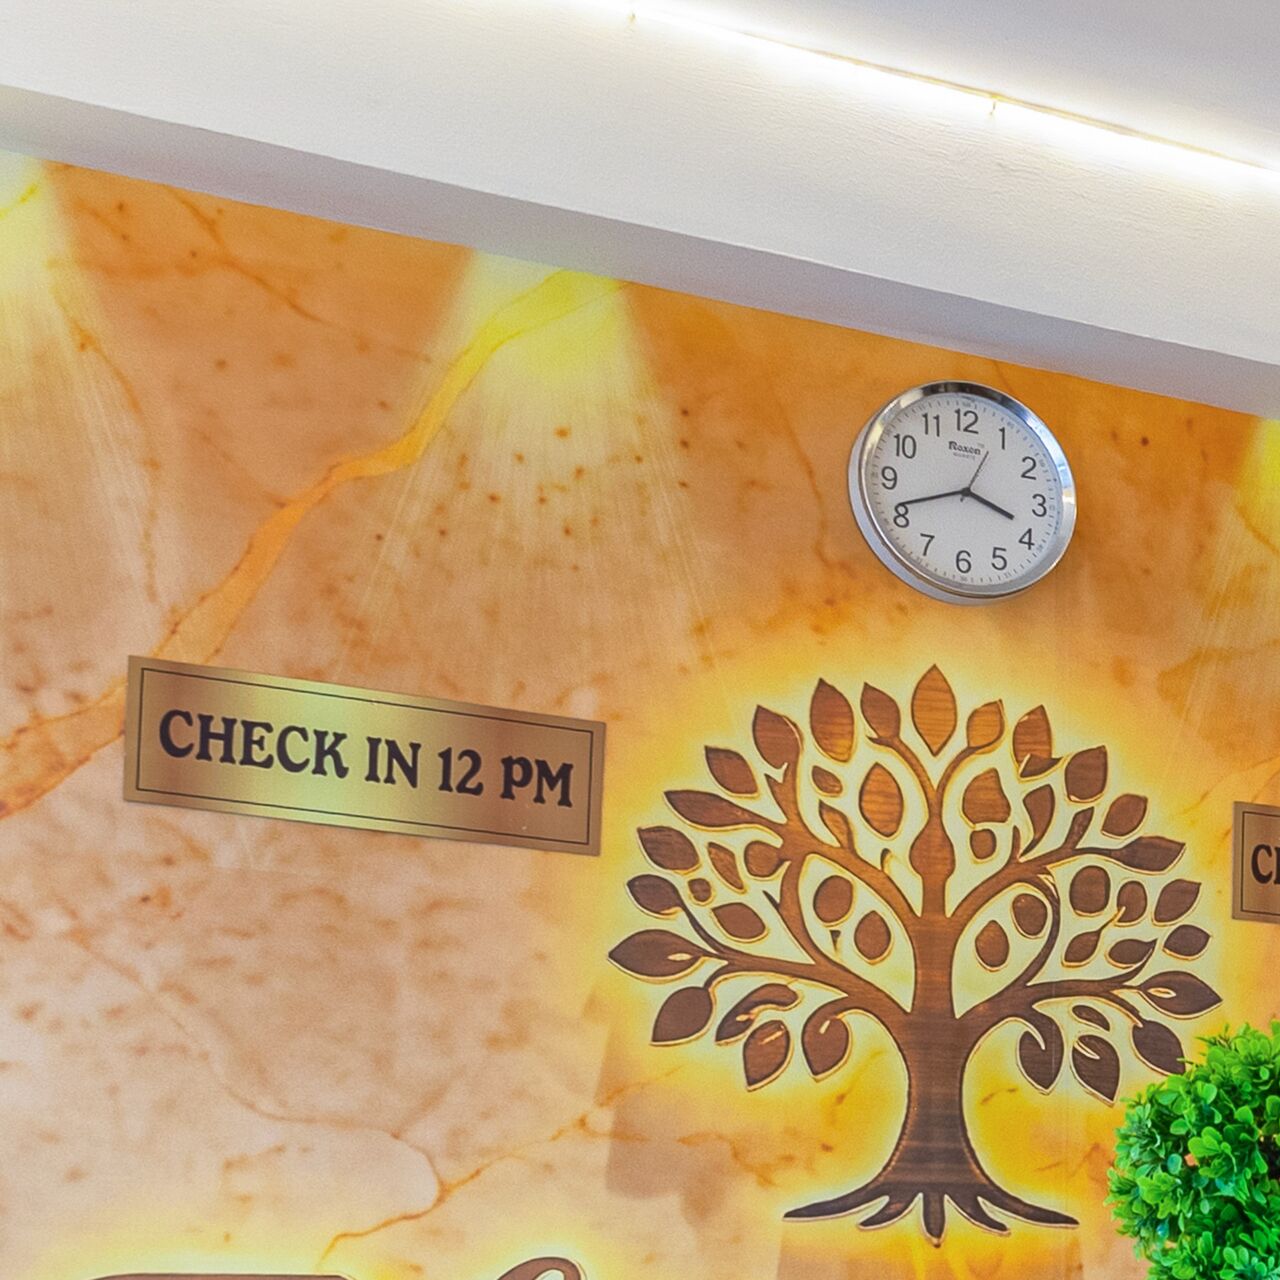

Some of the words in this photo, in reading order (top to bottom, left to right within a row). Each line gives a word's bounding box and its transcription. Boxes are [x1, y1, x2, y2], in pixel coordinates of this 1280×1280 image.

[922, 413, 941, 437] 11
[955, 409, 979, 434] 12
[893, 433, 917, 459] 10
[999, 428, 1006, 450] 1
[881, 466, 898, 490] 9
[1020, 456, 1037, 480] 2
[893, 504, 910, 528] 8
[1032, 494, 1047, 517] 3
[920, 533, 936, 556] 7
[1019, 528, 1035, 550] 4
[955, 550, 972, 574] 6
[992, 546, 1008, 571] 5
[159, 709, 349, 779] CHECK
[364, 736, 421, 789] IN
[437, 747, 484, 796] 12
[499, 755, 574, 808] PM
